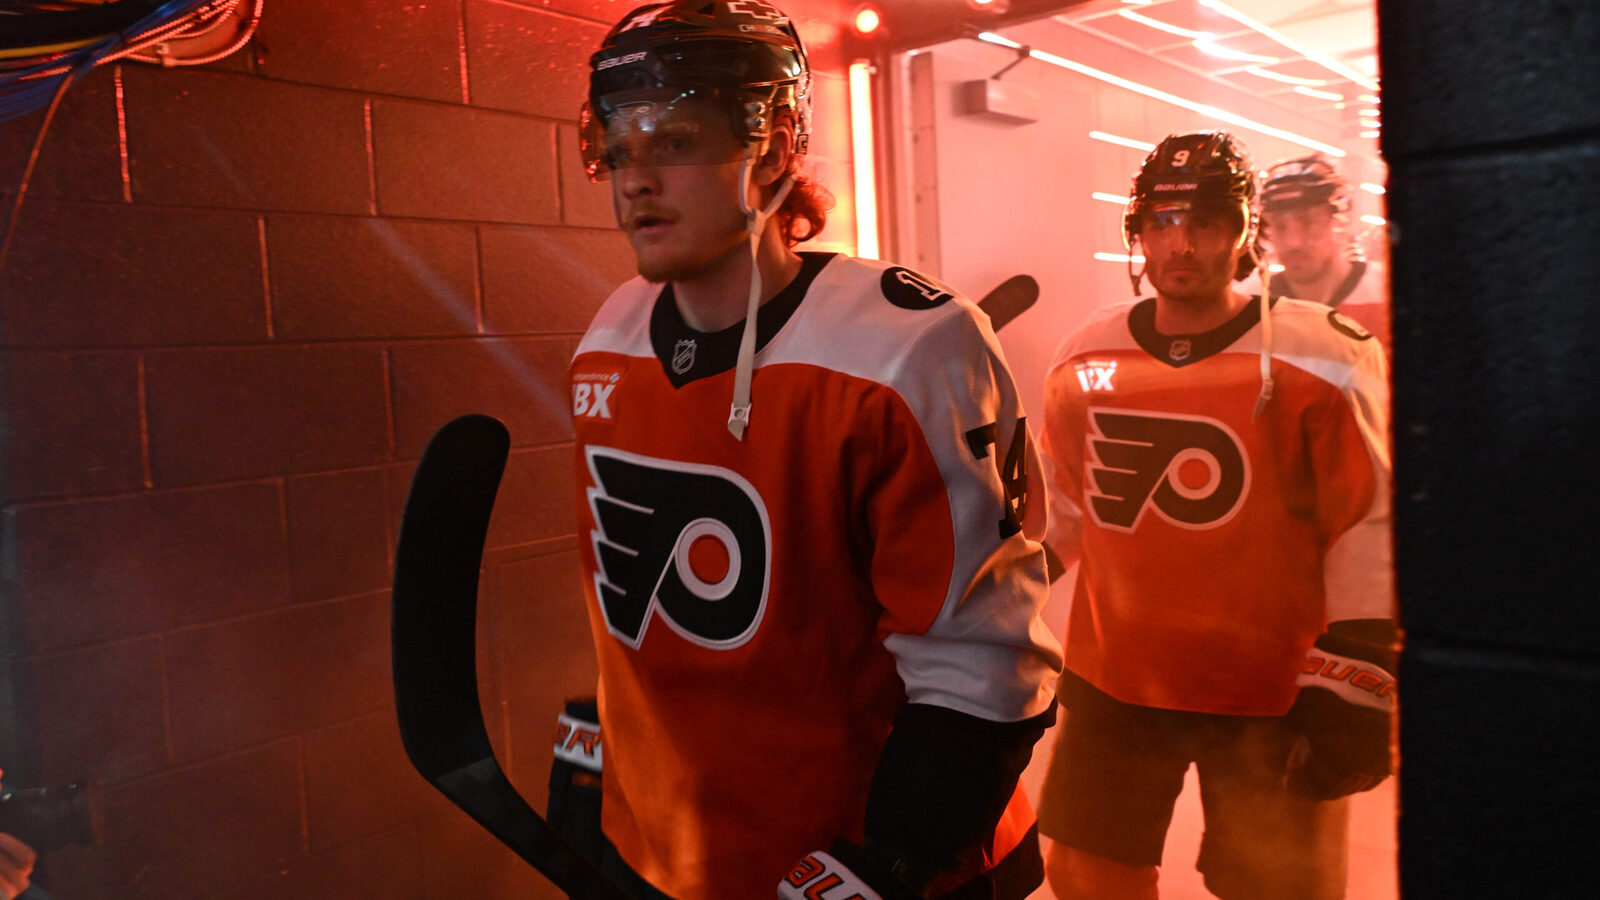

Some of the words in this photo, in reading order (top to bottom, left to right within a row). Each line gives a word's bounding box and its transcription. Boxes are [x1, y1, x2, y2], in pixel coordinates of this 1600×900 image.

[597, 51, 648, 70] BAUER
[1171, 149, 1190, 167] 9
[572, 382, 616, 419] BX
